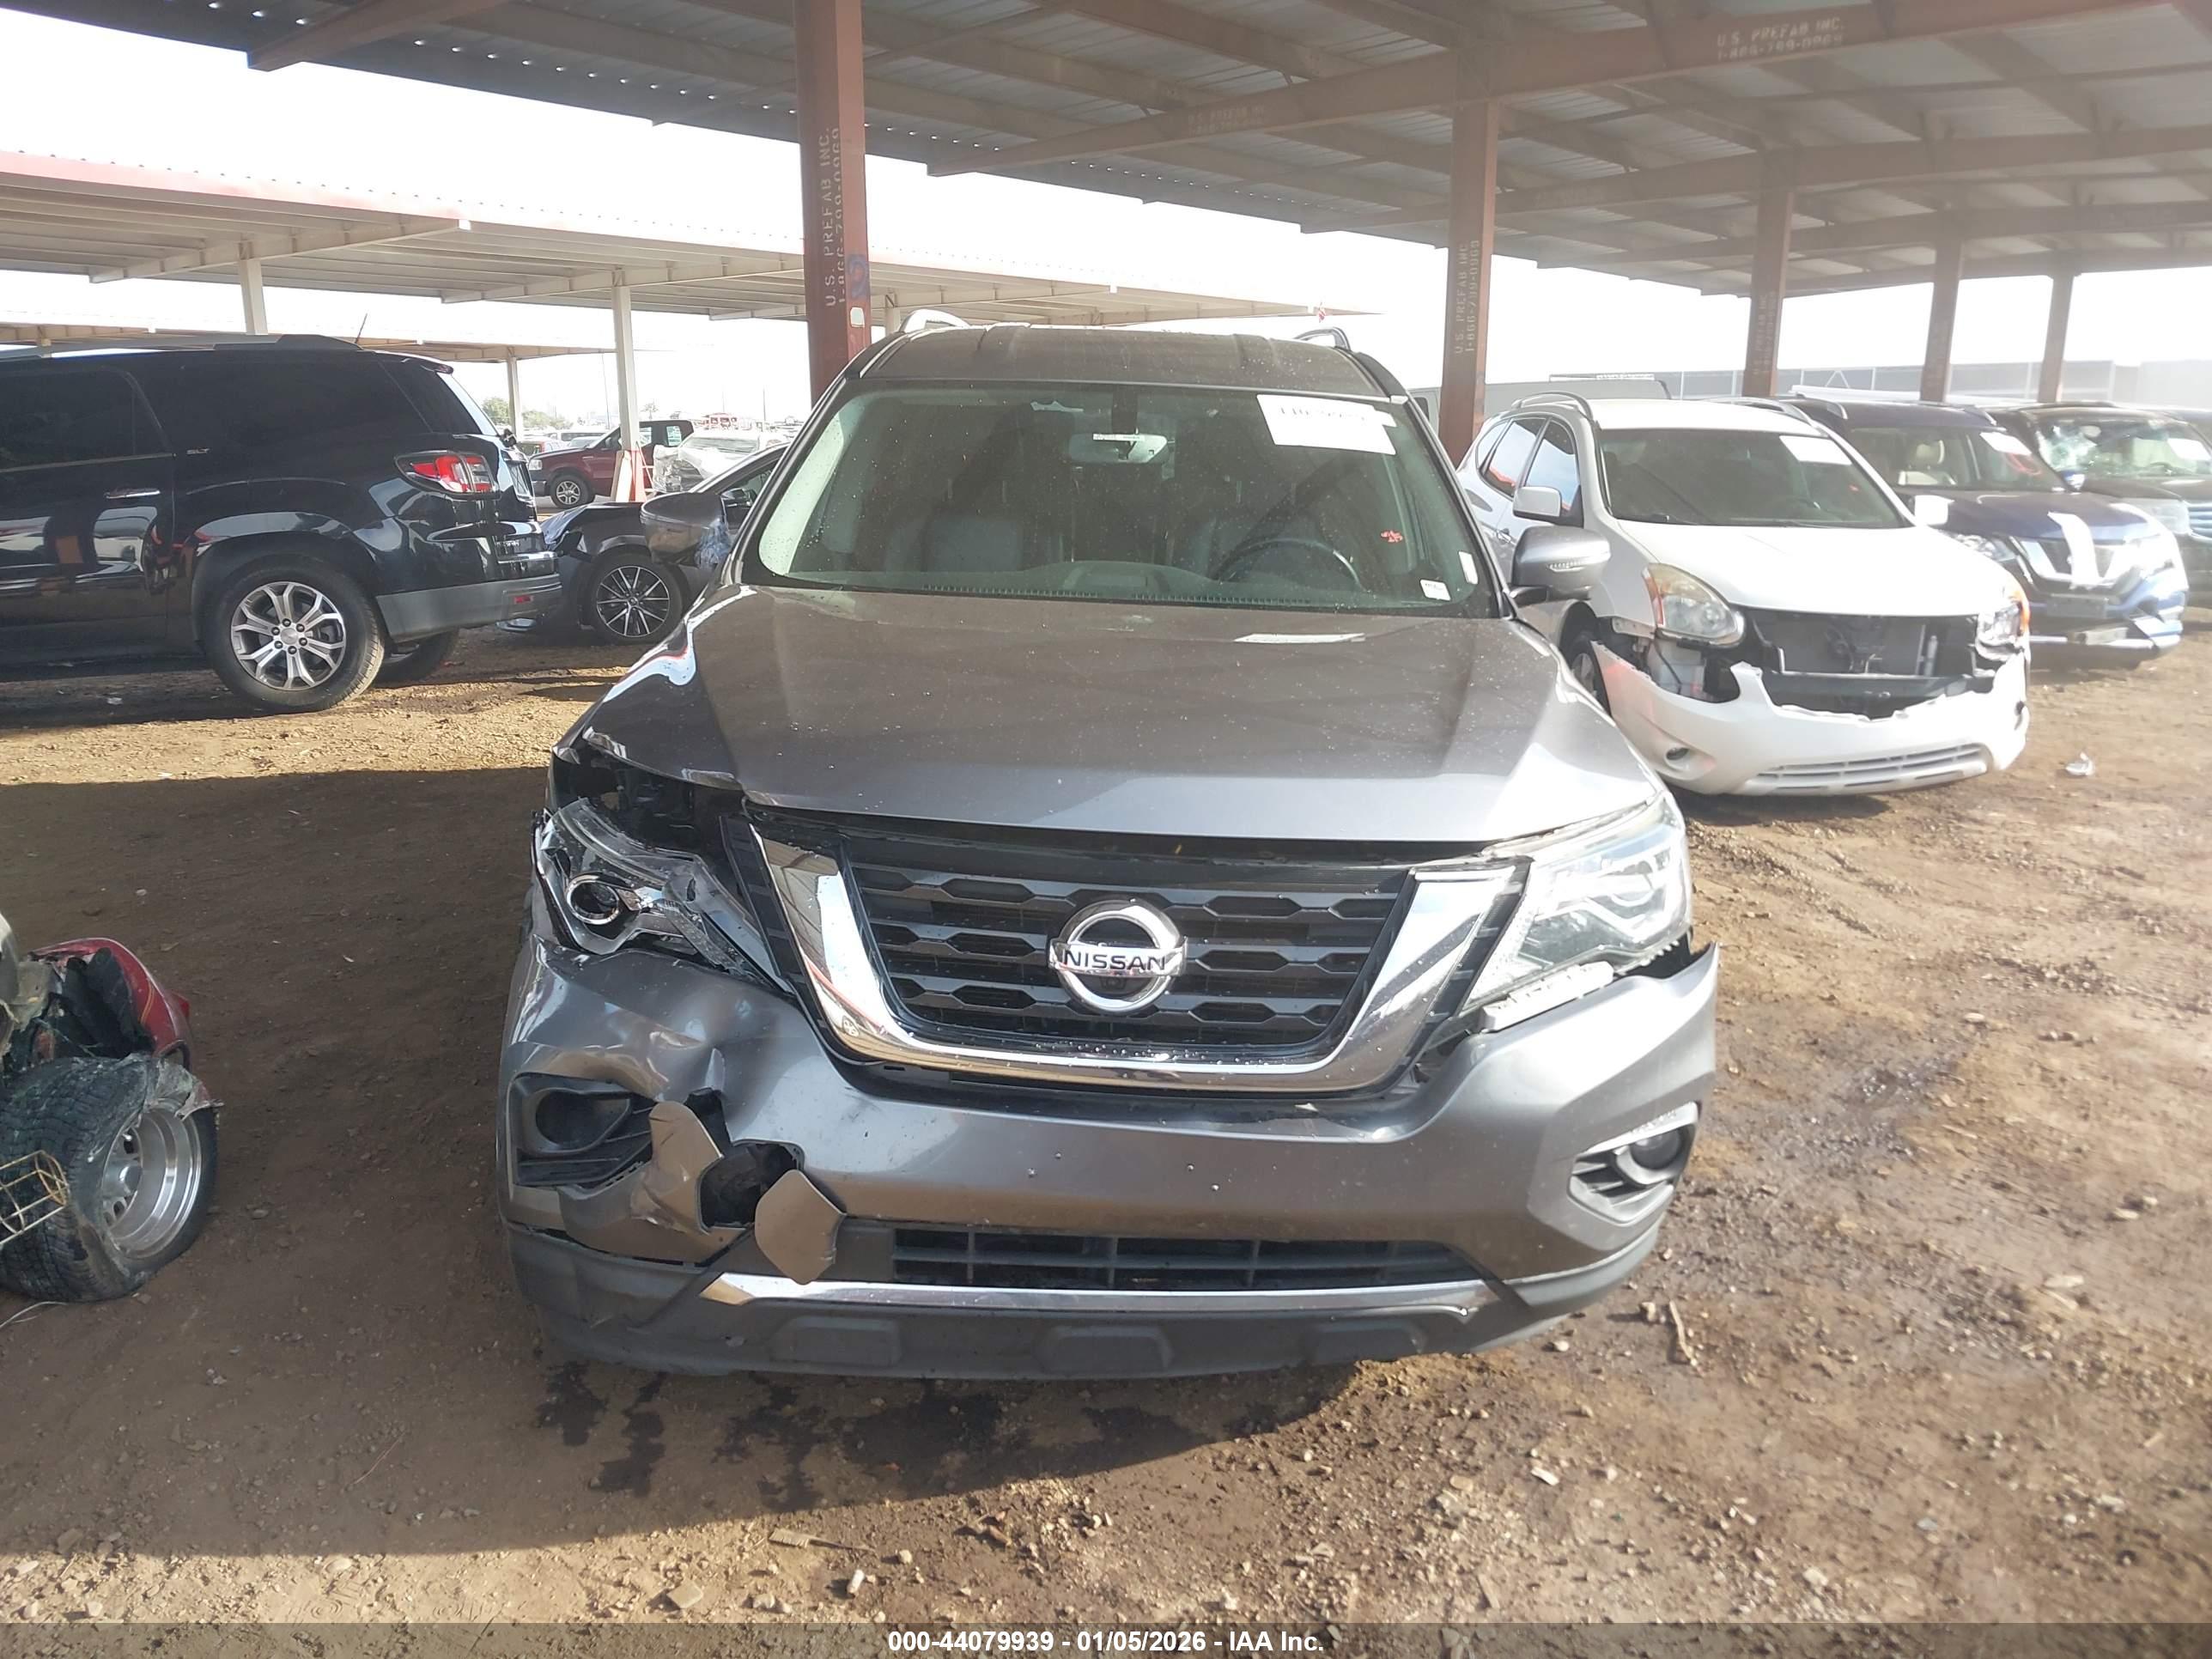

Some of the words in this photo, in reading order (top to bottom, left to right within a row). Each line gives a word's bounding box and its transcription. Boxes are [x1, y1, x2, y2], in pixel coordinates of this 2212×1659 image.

[1752, 22, 1808, 41] PREFAB
[818, 128, 831, 167] INC.
[820, 178, 834, 256] PREFAB
[824, 268, 836, 307] U.S.
[1456, 271, 1467, 322] PREFAB
[1063, 949, 1165, 971] NISSAN
